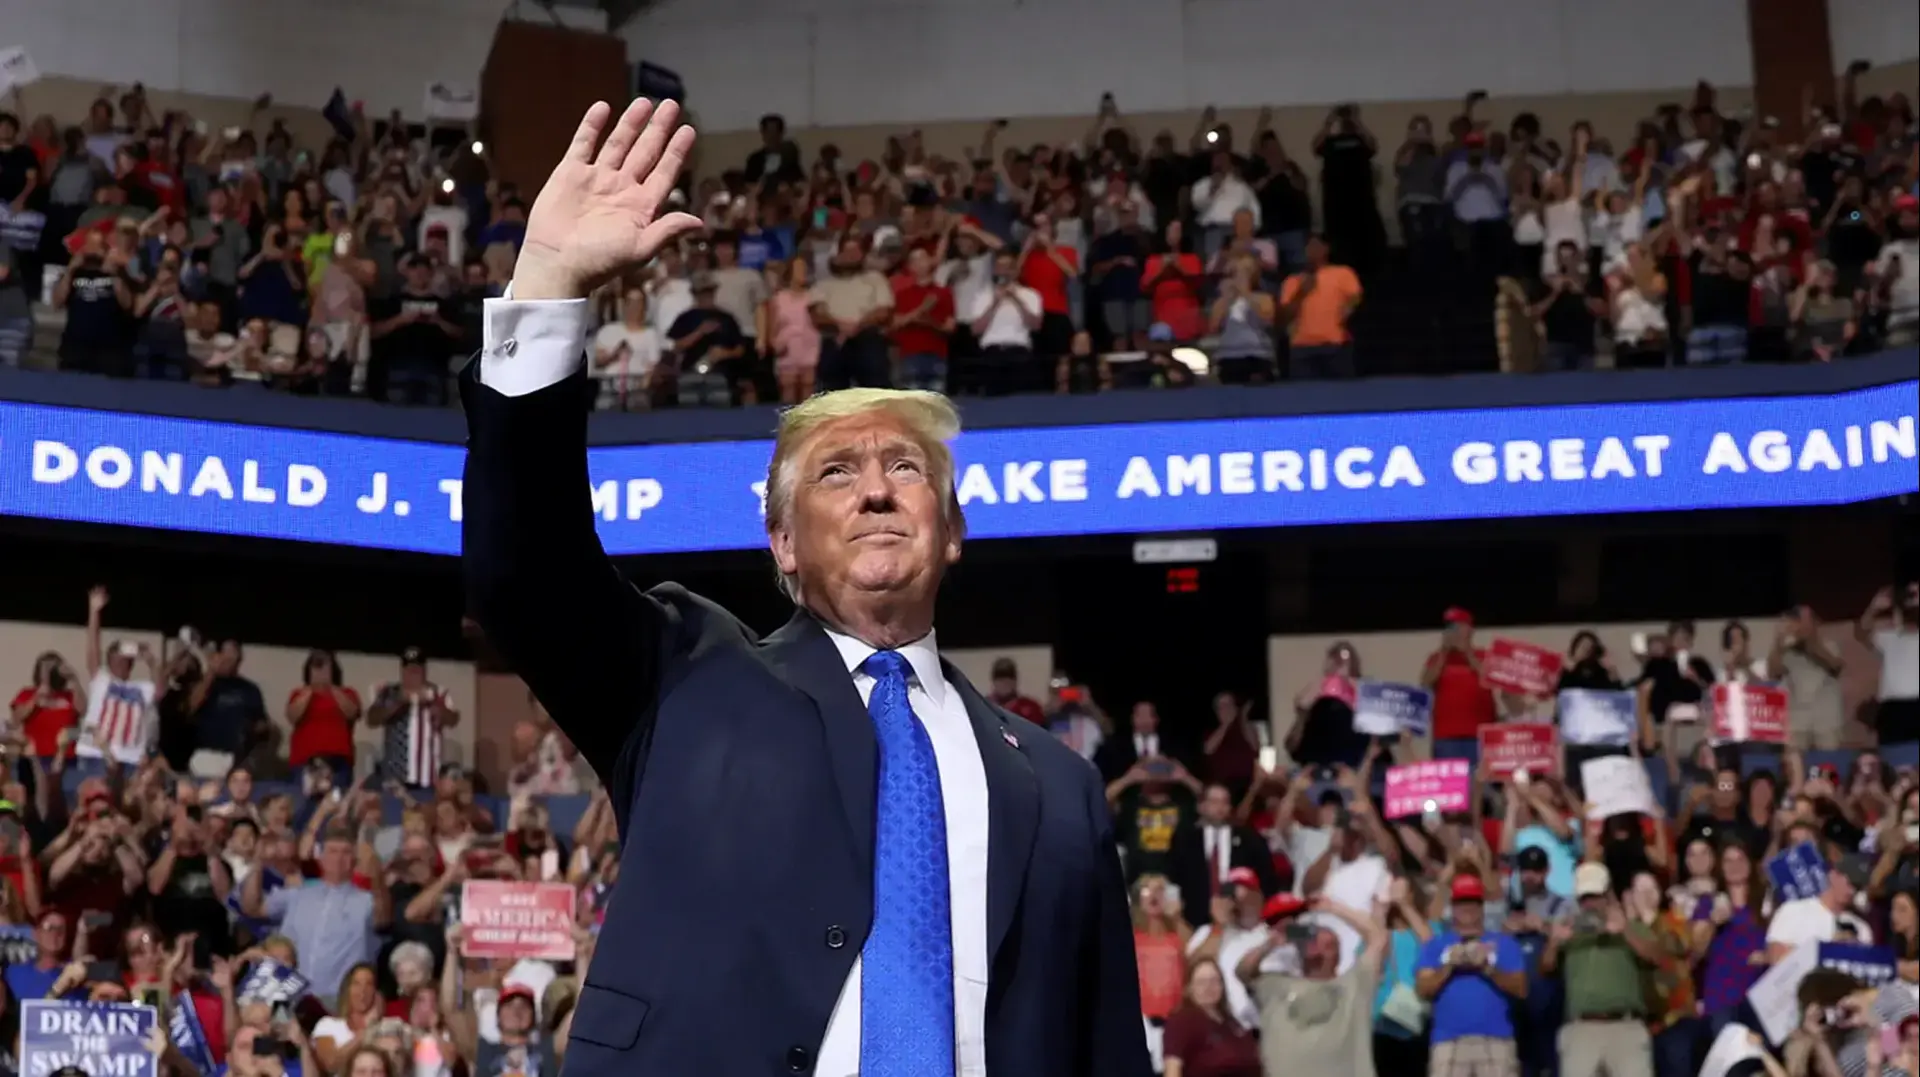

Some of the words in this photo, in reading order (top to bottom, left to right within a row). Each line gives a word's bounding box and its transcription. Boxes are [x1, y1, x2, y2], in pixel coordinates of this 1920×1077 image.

[957, 459, 1088, 505] AKE
[1117, 445, 1426, 499] AMERICA
[1451, 435, 1670, 484] GREAT
[1702, 415, 1917, 474] AGAIN
[32, 440, 328, 507] DONALD
[356, 472, 410, 516] J.
[439, 478, 663, 521] TMP
[40, 1009, 140, 1036] DRAIN
[70, 1034, 109, 1055] THE
[30, 1051, 147, 1077] SWAMP
